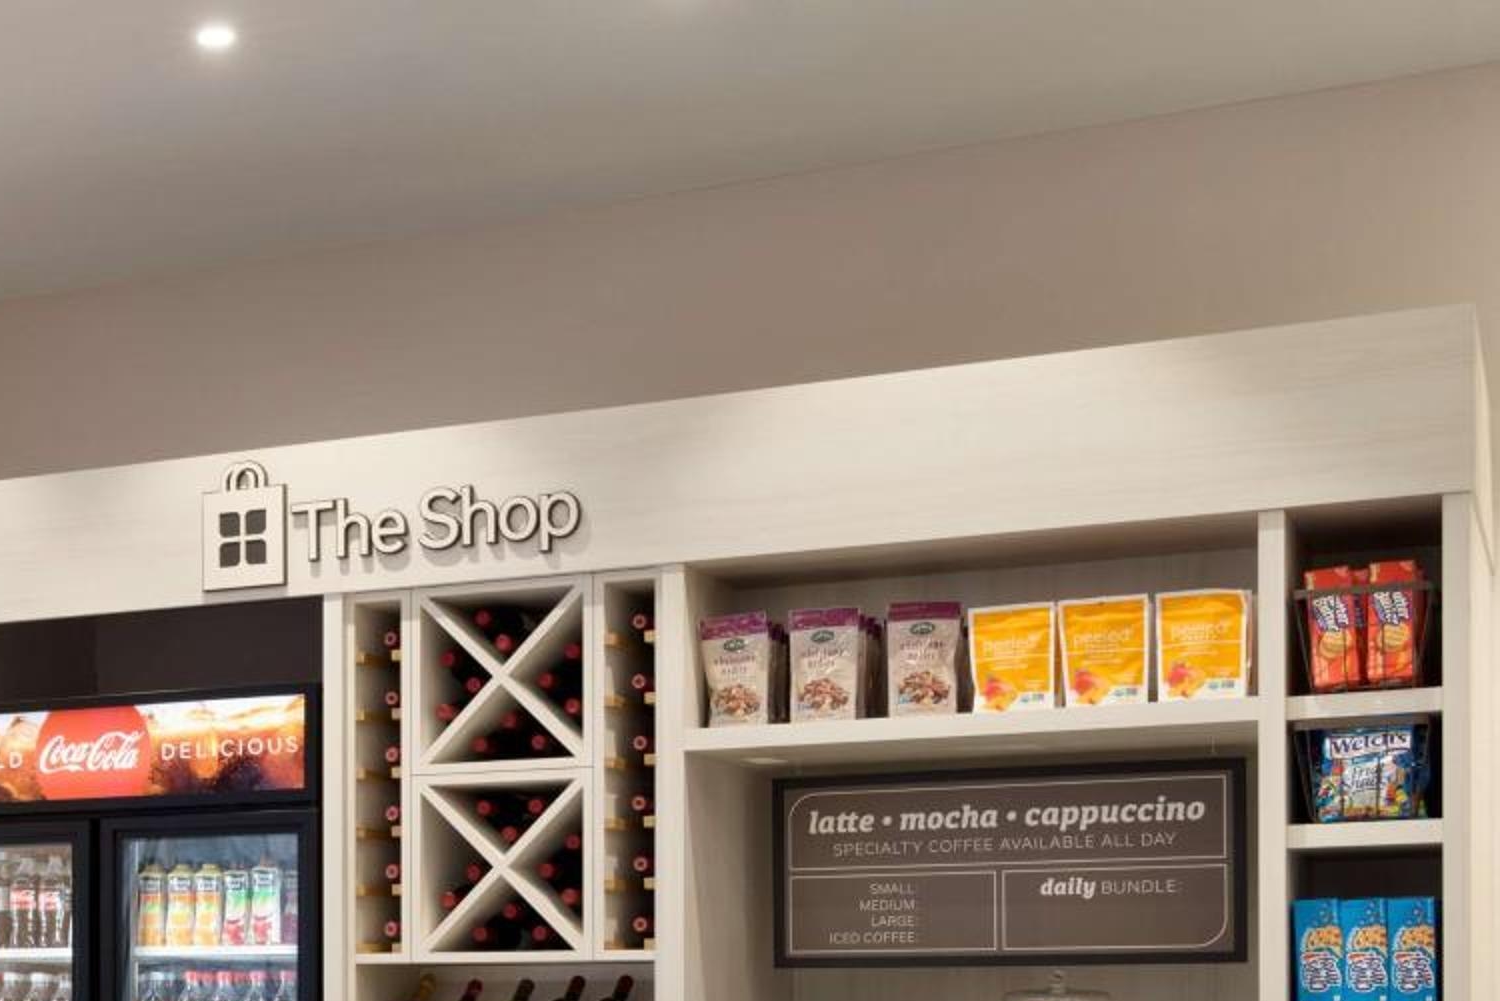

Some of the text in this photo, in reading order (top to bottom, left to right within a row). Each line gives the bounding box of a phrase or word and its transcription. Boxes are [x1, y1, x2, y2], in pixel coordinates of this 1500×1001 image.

[291, 484, 583, 563] The Shop
[159, 735, 300, 762] DELICIOUS
[807, 795, 1206, 836] latte mocha cappuccino
[832, 831, 1178, 857] SPECIALTY COFFEE AVAILABLE ALL DAY
[1039, 876, 1097, 900] daily
